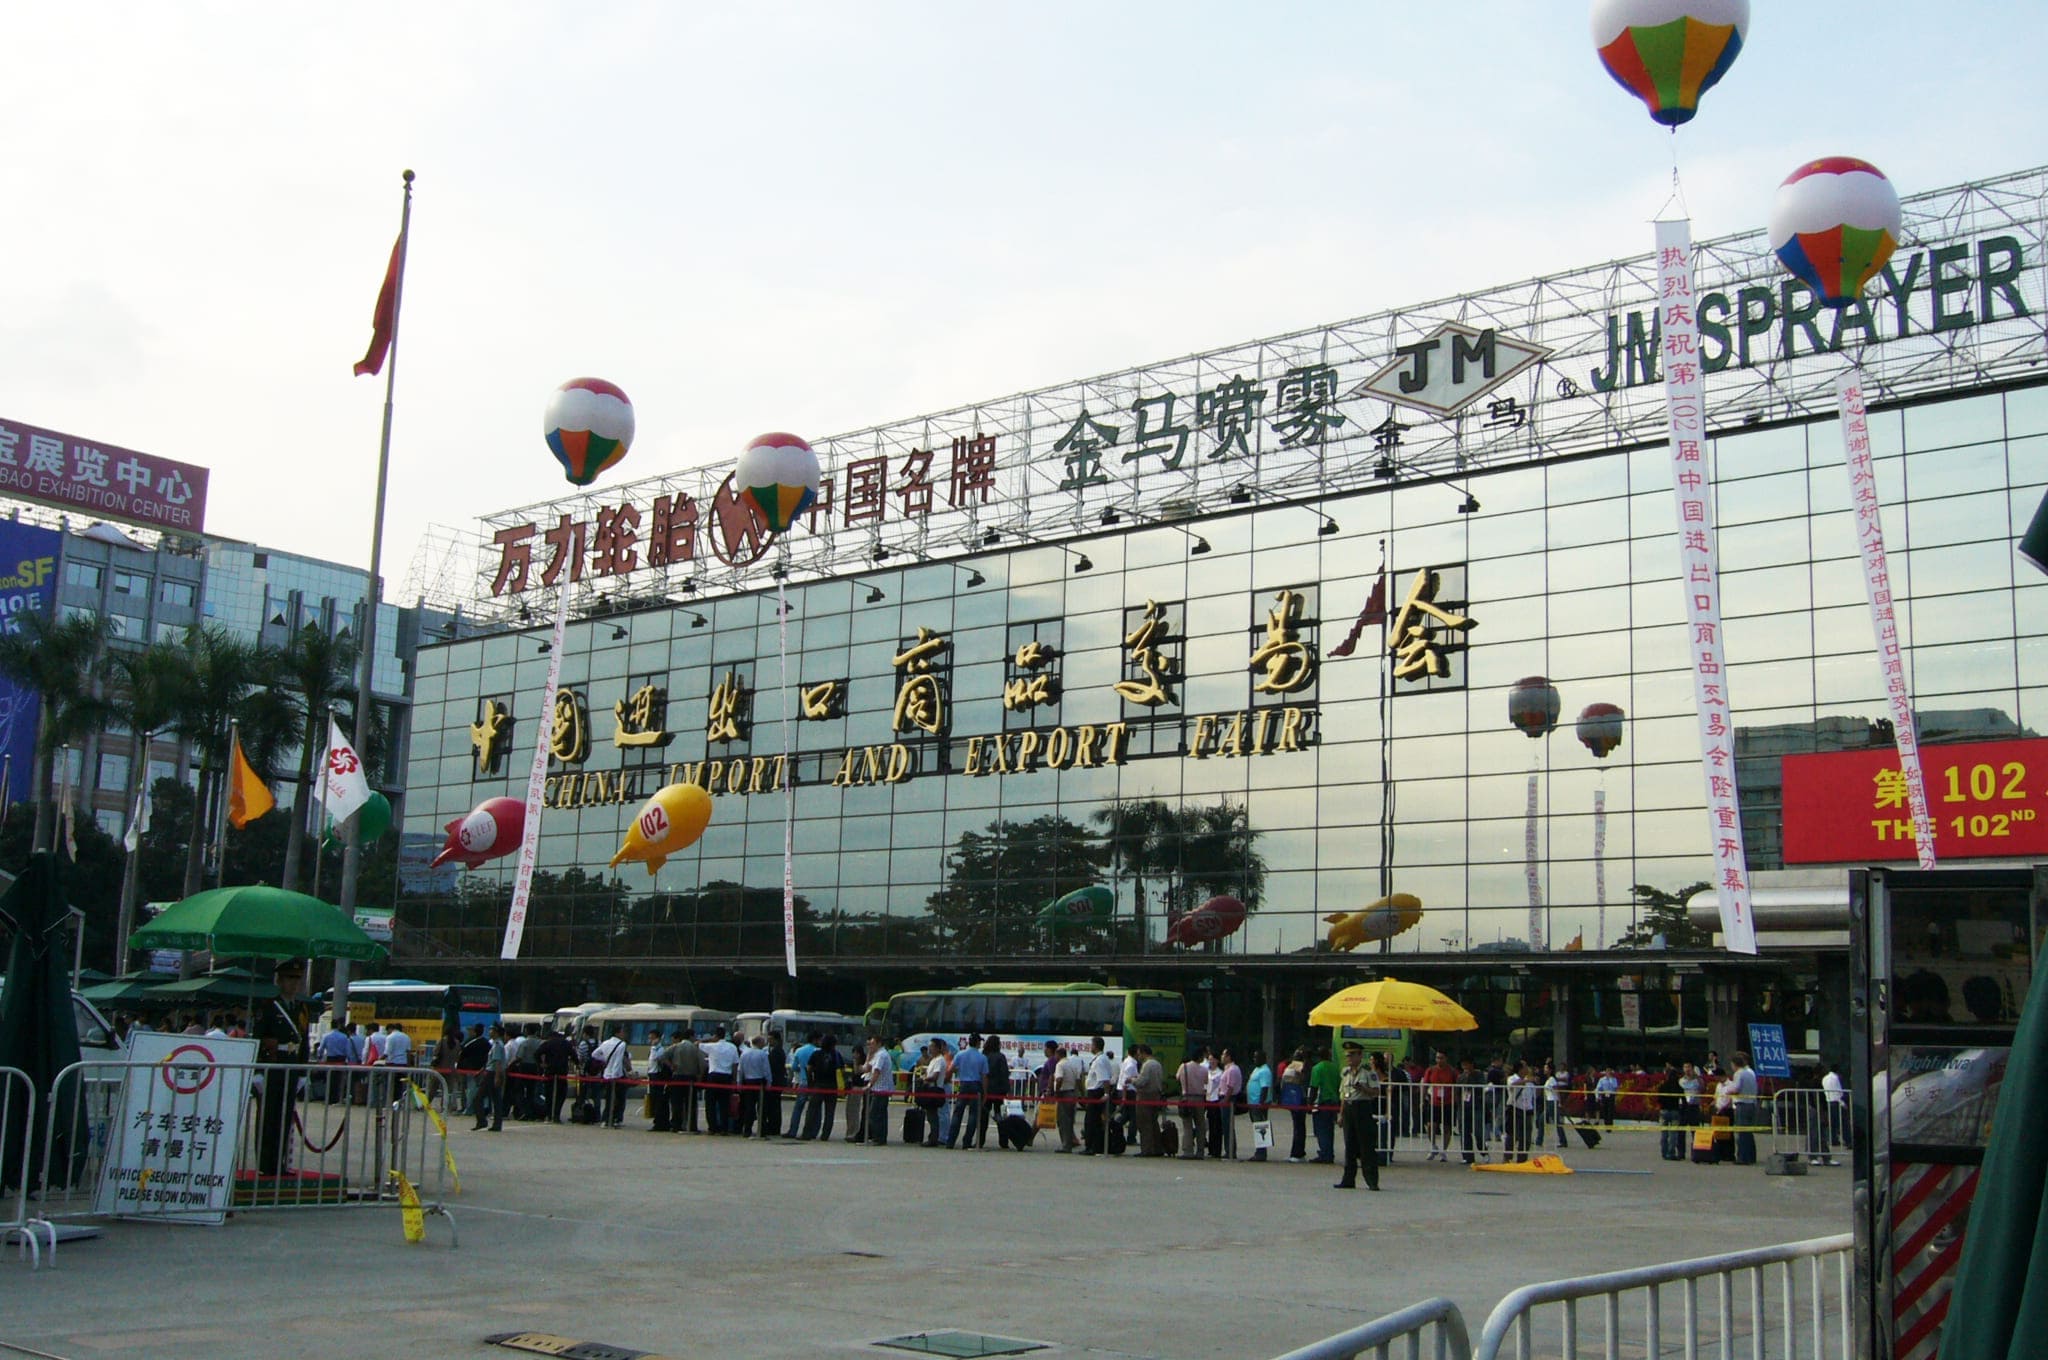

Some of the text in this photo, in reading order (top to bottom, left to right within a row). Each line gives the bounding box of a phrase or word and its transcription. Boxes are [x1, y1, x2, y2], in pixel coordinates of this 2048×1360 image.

[1697, 235, 2031, 375] SPRAYER
[1395, 327, 1496, 394] JM
[1053, 363, 1346, 491] 金马喷雾
[38, 477, 127, 511] EXHIBITION
[132, 498, 192, 526] CENTER
[491, 491, 699, 598] 万力轮胎
[541, 707, 1304, 809] CHINA IMPORT AND EXPORT FAIR
[1943, 761, 2027, 803] 102
[638, 806, 669, 840] 102
[1754, 1047, 1785, 1062] TAXI
[133, 1111, 224, 1135] 汽车安检
[141, 1138, 208, 1160] 请慢行
[109, 1167, 145, 1183] VEHICL
[194, 1173, 225, 1187] CHECK
[118, 1187, 152, 1202] PLEASE
